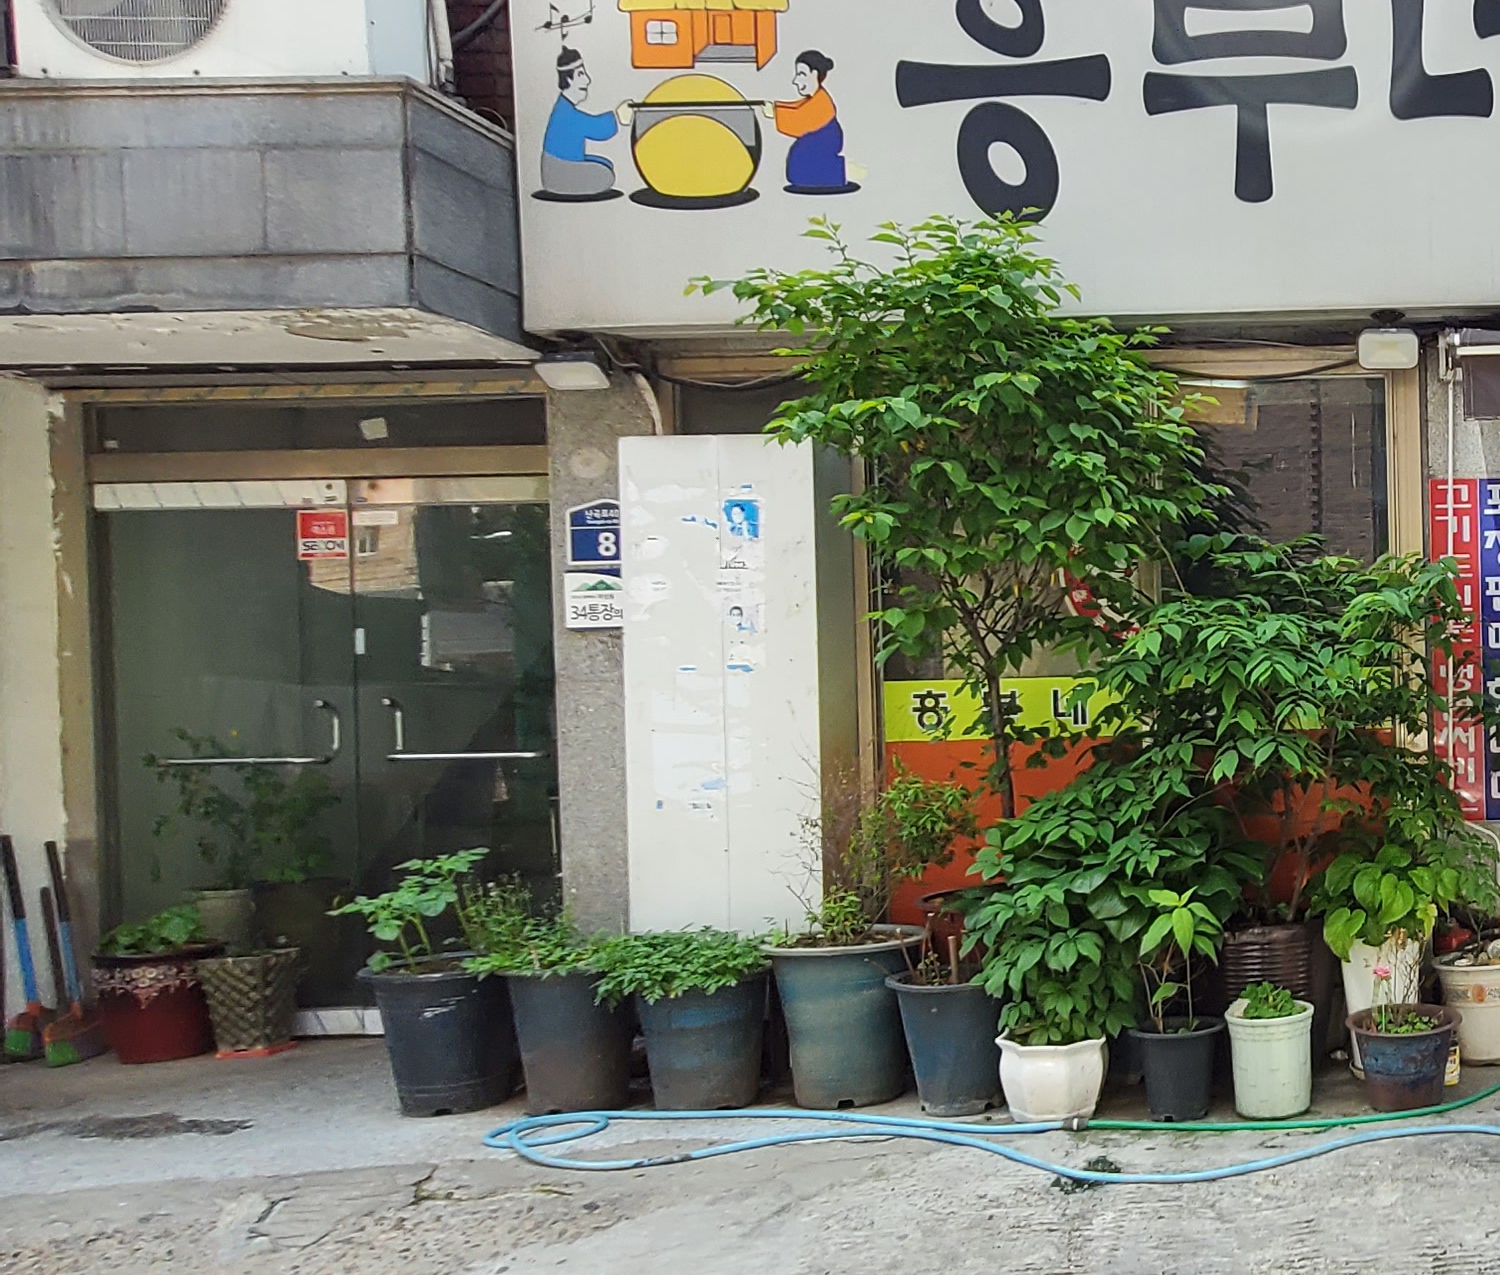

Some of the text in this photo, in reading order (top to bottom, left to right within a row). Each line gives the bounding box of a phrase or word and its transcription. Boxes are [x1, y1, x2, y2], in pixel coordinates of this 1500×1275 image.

[584, 508, 620, 520] 난곡로40
[597, 531, 617, 557] 8
[570, 602, 624, 622] 34통장의
